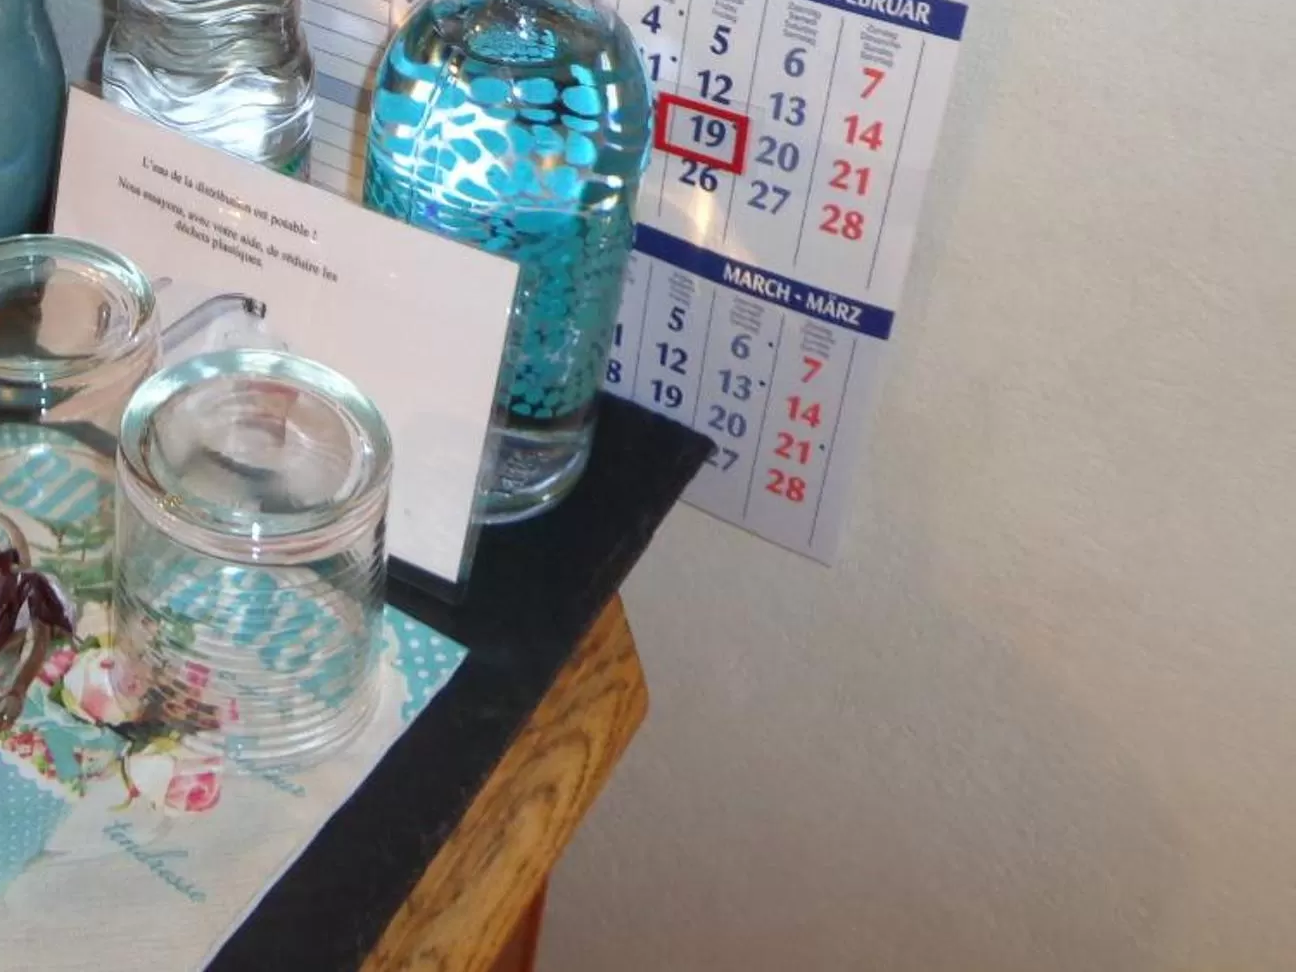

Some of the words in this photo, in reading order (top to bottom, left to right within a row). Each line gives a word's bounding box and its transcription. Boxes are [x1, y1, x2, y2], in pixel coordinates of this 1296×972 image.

[641, 4, 662, 34] 4
[709, 24, 732, 55] 5
[784, 47, 807, 78] 6
[859, 66, 886, 100] 7
[697, 69, 733, 105] 12
[769, 91, 808, 127] 13
[843, 114, 884, 151] 14
[690, 115, 726, 147] 19
[755, 135, 800, 173] 20
[828, 159, 871, 196] 21
[678, 158, 719, 192] 26
[747, 180, 791, 216] 27
[818, 203, 865, 241] 28
[723, 262, 792, 302] MARCH
[806, 292, 862, 327] MÄRZ
[656, 342, 688, 375] 12
[719, 369, 752, 402] 13
[787, 395, 822, 428] 14
[667, 306, 686, 332] 5
[730, 333, 752, 360] 6
[801, 356, 823, 384] 7
[606, 358, 622, 384] 8
[651, 379, 683, 409] 19
[708, 404, 747, 438] 20
[774, 431, 811, 465] 21
[766, 468, 806, 503] 28
